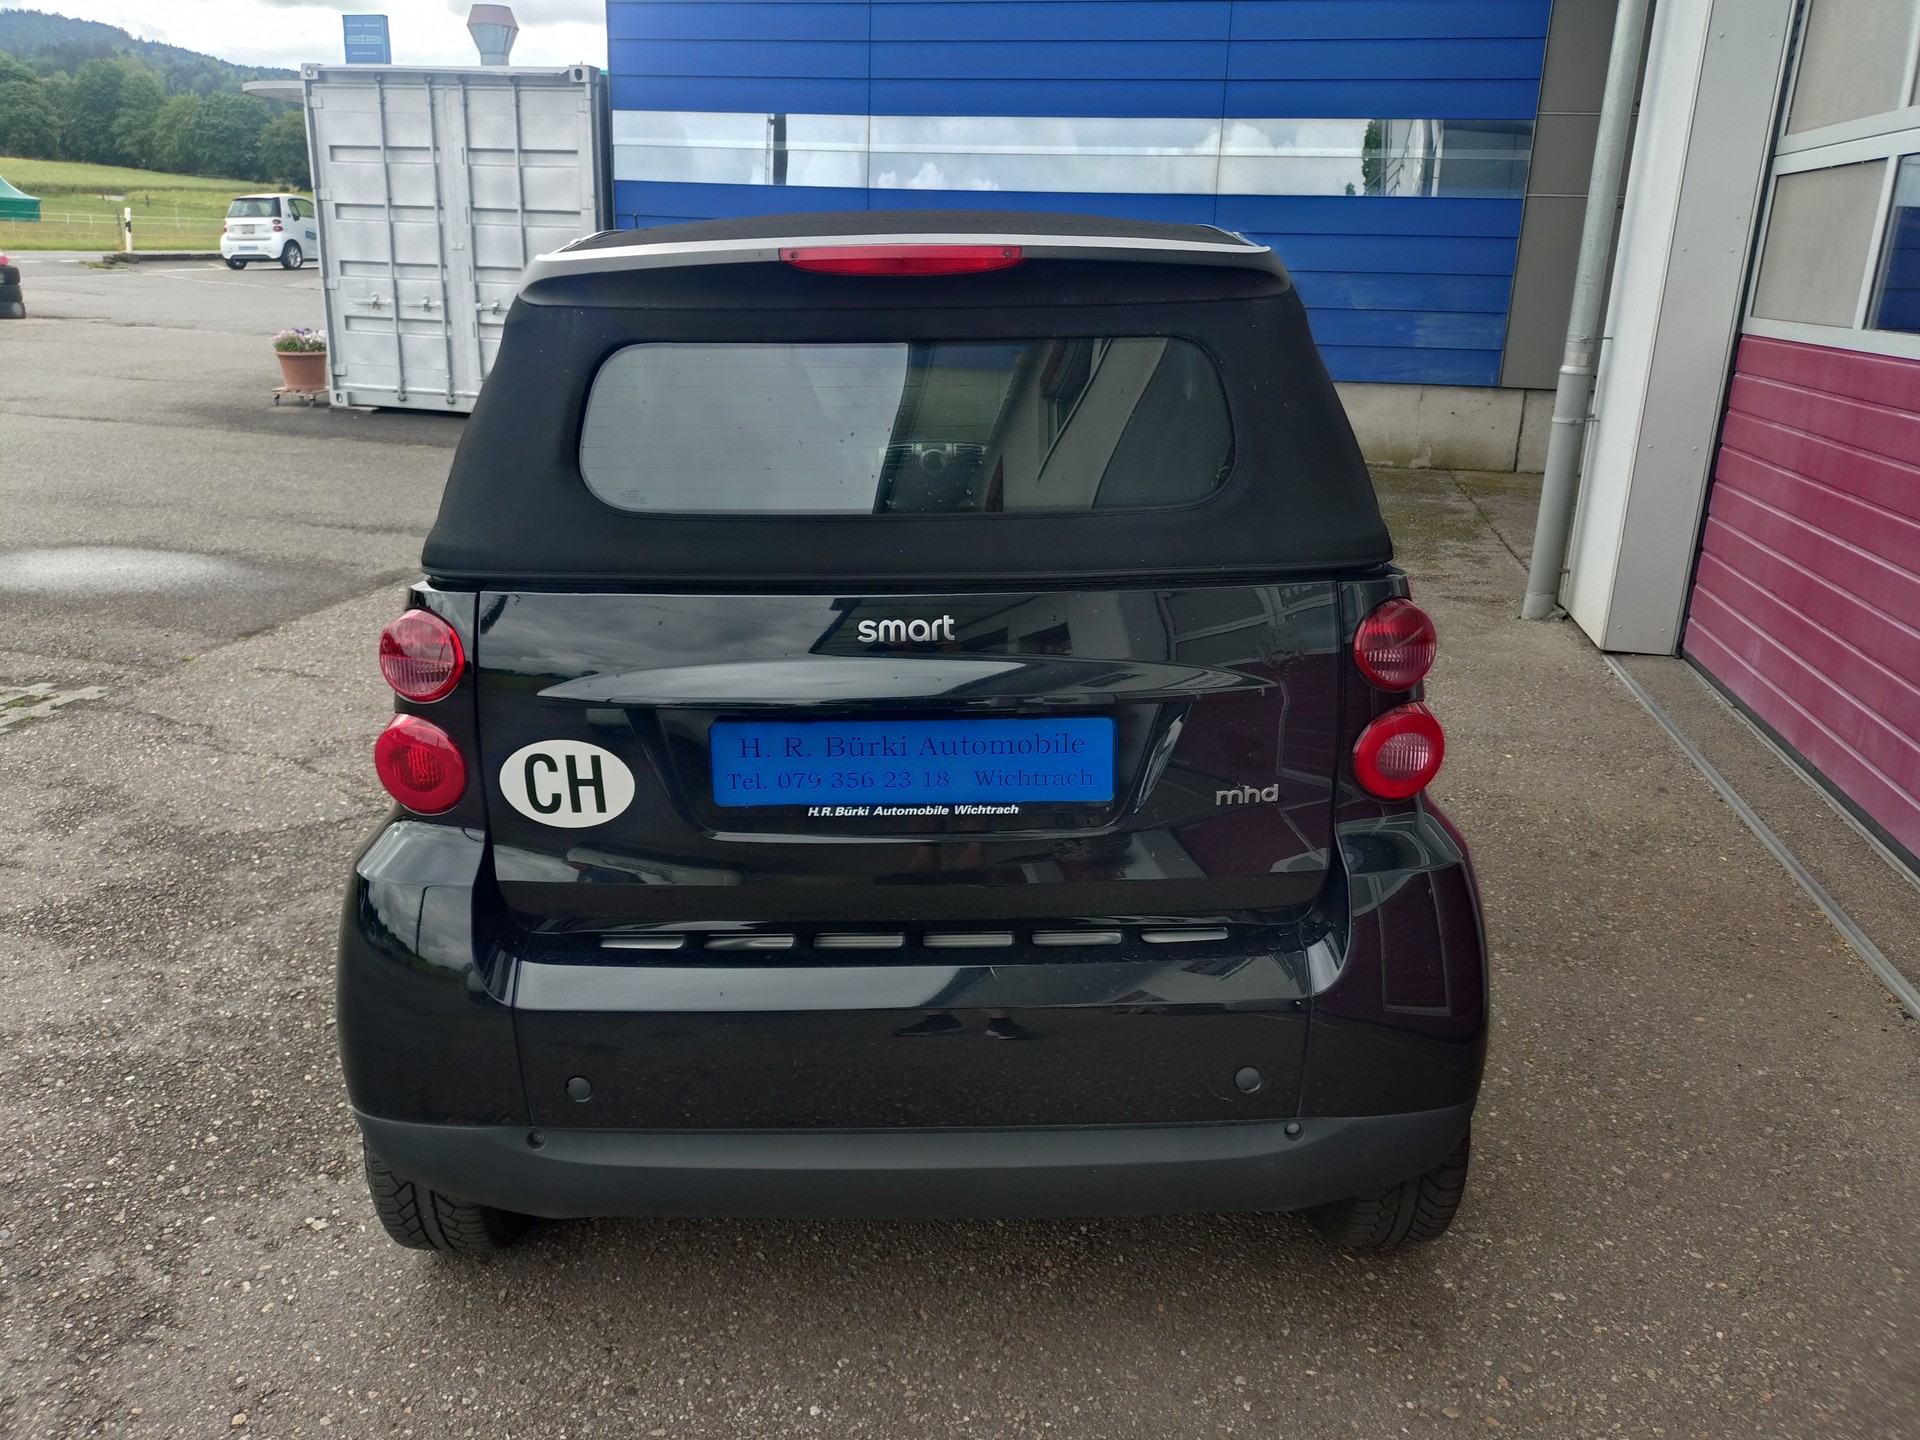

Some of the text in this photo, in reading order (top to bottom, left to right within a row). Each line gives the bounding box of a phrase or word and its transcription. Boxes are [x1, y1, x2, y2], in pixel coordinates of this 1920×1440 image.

[857, 614, 956, 643] smart
[740, 732, 1086, 758] H. R. Bürki Automobile
[524, 752, 607, 815] CH
[726, 768, 1094, 790] Tel. 079 356 23 18 Wichtrach
[1215, 783, 1279, 806] mhd
[873, 805, 949, 816] Automobile
[954, 804, 1019, 815] Wichtrach
